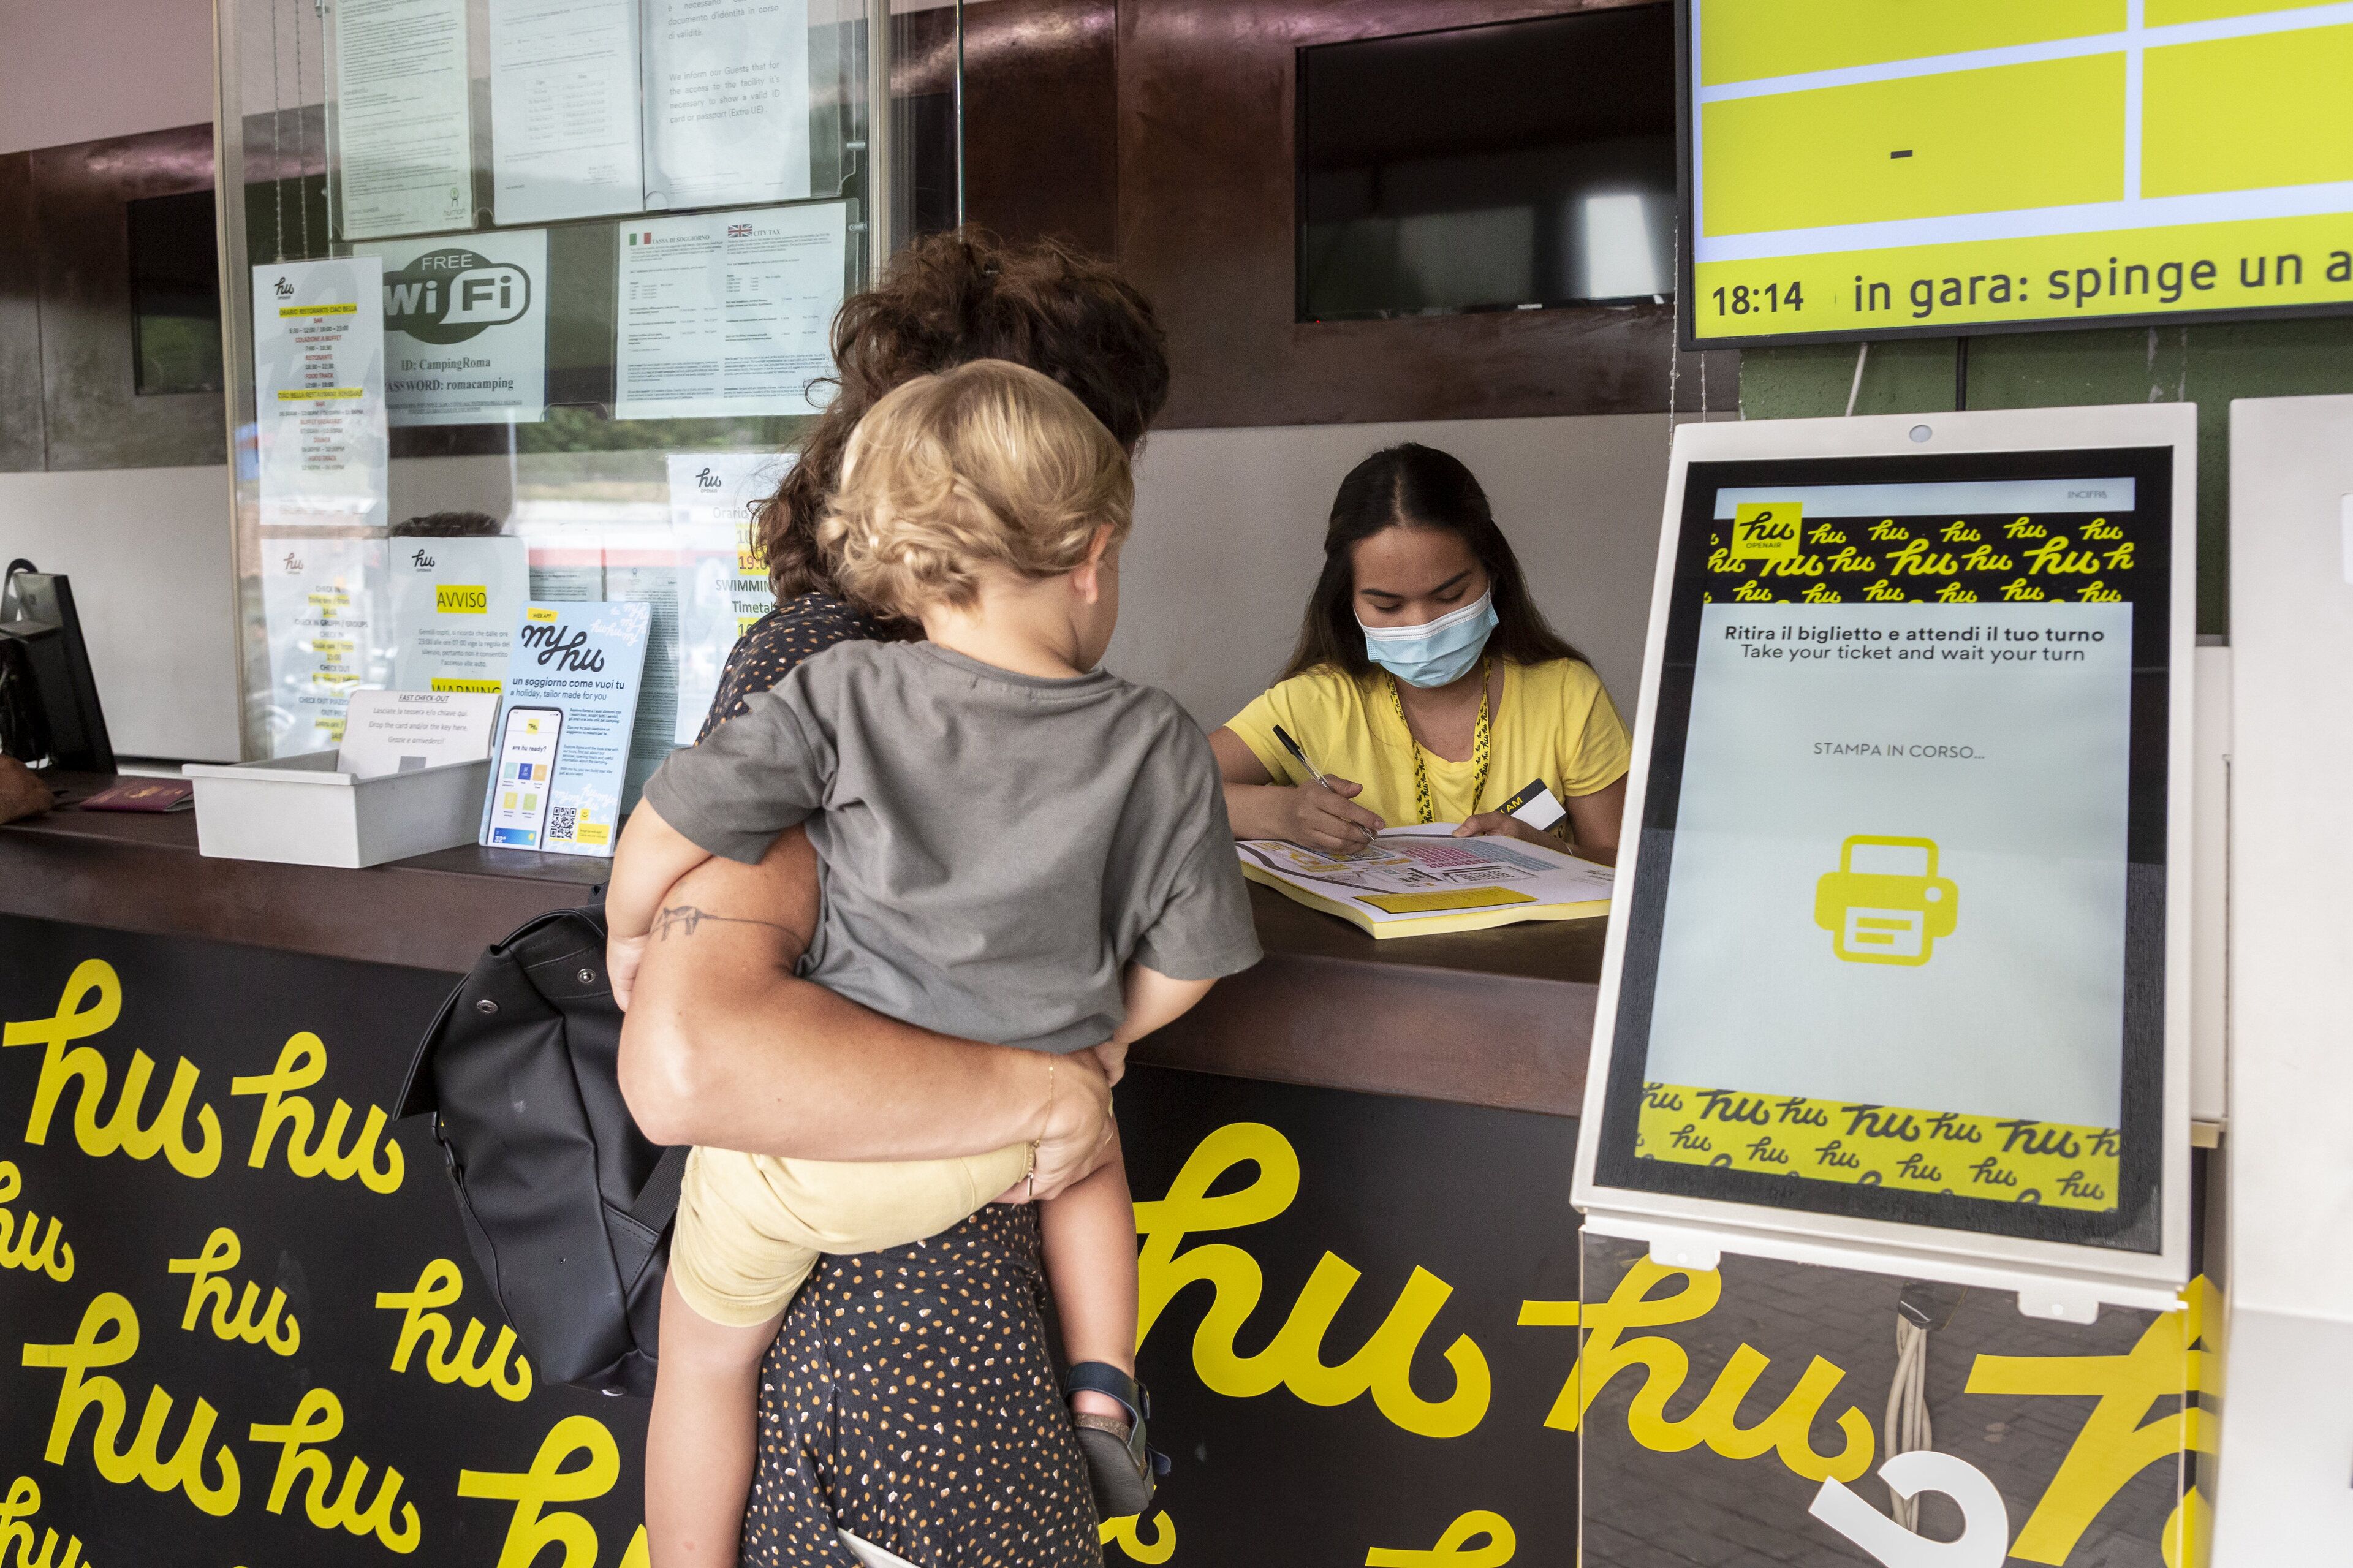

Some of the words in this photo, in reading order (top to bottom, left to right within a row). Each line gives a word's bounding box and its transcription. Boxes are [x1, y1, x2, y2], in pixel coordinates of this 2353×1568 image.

[669, 15, 708, 26] documento
[711, 9, 745, 20] d'identità
[759, 5, 779, 13] corso
[684, 70, 707, 80] inform
[724, 66, 749, 75] Guests
[752, 63, 766, 72] that
[685, 85, 708, 93] access
[741, 77, 764, 88] facility
[670, 100, 704, 109] necessary
[720, 95, 738, 104] show
[751, 91, 768, 100] valid
[670, 113, 685, 123] card
[697, 110, 726, 122] passport
[729, 108, 749, 118] (Extra
[422, 254, 472, 270] FREE
[274, 277, 294, 295] hu
[1855, 275, 1891, 312] in
[1910, 273, 2028, 319] gara:
[2048, 256, 2217, 308] spinge
[2240, 253, 2302, 288] un
[1713, 281, 1804, 316] 18:14
[401, 360, 417, 371] ID:
[419, 357, 490, 372] CampingRoma
[447, 377, 513, 392] romacamping
[695, 467, 721, 488] hu
[1740, 511, 1795, 541] hu
[1808, 523, 1846, 544] hu
[1868, 519, 1909, 541] hu
[2003, 516, 2047, 539] hu
[2079, 518, 2123, 540] hu
[283, 553, 303, 570] hu
[412, 549, 435, 567] hu
[1827, 546, 1876, 572] hu
[1885, 538, 1958, 576] hu
[1961, 544, 2013, 571] hu
[2023, 536, 2100, 575] hu
[716, 580, 770, 592] SWIMMIN
[1733, 580, 1773, 602] hu
[1863, 579, 1904, 601] hu
[2000, 578, 2044, 600] hu
[437, 592, 487, 607] AVVISO
[1725, 626, 1775, 640] Ritira
[1781, 626, 1792, 640] il
[1798, 626, 1882, 644] biglietto
[1889, 631, 1900, 641] e
[1906, 626, 1980, 642] attendi
[1987, 626, 1998, 642] il
[2004, 629, 2039, 642] tuo
[2045, 629, 2105, 642] turno
[1741, 643, 1783, 658] Take
[1789, 648, 1832, 662] your
[1838, 645, 1892, 659] ticket
[1898, 645, 1934, 660] and
[1942, 646, 1984, 661] wait
[1991, 650, 2037, 664] your
[2044, 647, 2085, 661] turn
[525, 677, 567, 688] soggiorno
[596, 679, 614, 689] vuoi
[616, 680, 625, 689] tu
[516, 689, 542, 699] holiday,
[544, 689, 561, 698] tailor
[1813, 743, 1881, 756] STAMPA
[1887, 744, 1904, 756] IN
[1909, 745, 1985, 759] CORSO...
[1506, 797, 1523, 812] AM
[2, 958, 222, 1179] hu
[230, 1031, 405, 1194] hu
[1670, 1123, 1712, 1152] hu
[1814, 1140, 1860, 1169] hu
[1896, 1153, 1942, 1182] hu
[2056, 1170, 2105, 1200] hu
[1131, 1121, 1492, 1439] hu
[168, 1227, 300, 1357] hu
[375, 1258, 533, 1402] hu
[1517, 1254, 1876, 1484] hu
[21, 1292, 241, 1517] hu
[249, 1388, 422, 1554] hu
